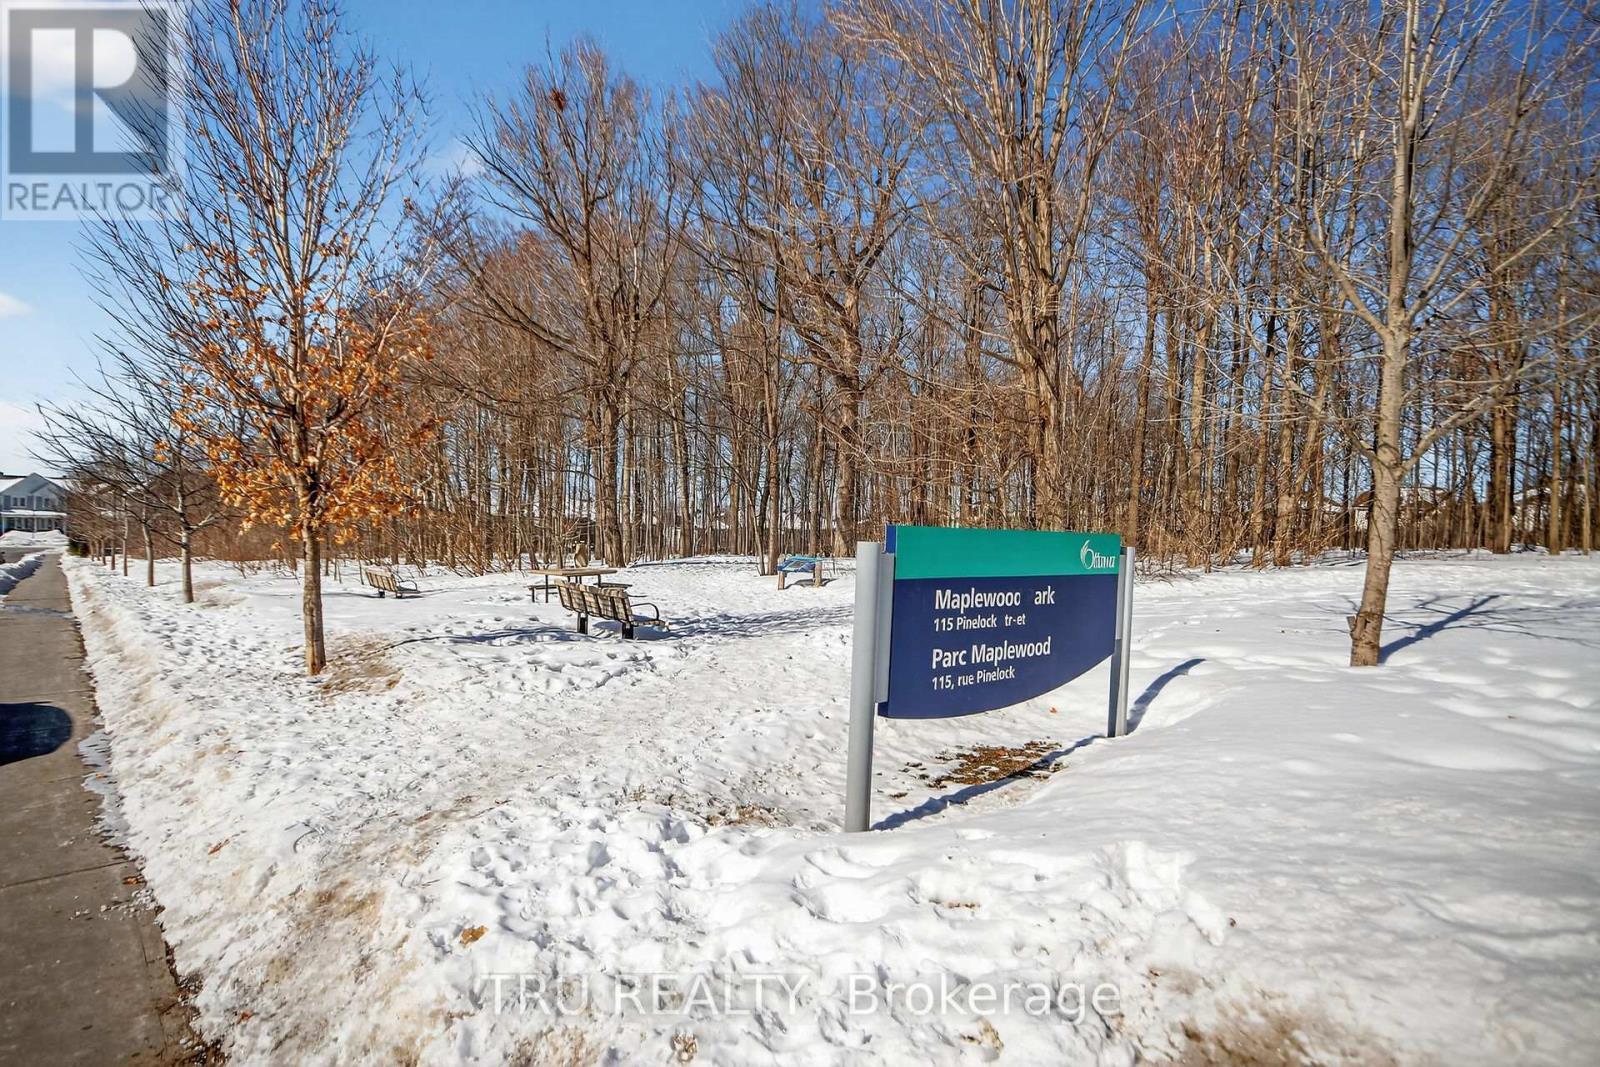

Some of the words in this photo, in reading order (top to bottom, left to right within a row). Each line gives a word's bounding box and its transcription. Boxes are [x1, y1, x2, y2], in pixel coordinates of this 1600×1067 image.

[1034, 585, 1056, 605] ark
[934, 617, 954, 632] 115
[956, 614, 998, 630] Pinelock
[1004, 613, 1026, 627] tret
[932, 648, 967, 670] Parc
[971, 636, 1052, 667] Maplewood
[932, 674, 955, 691] 115,
[957, 674, 975, 687] rue
[976, 665, 1016, 683] Pinelock
